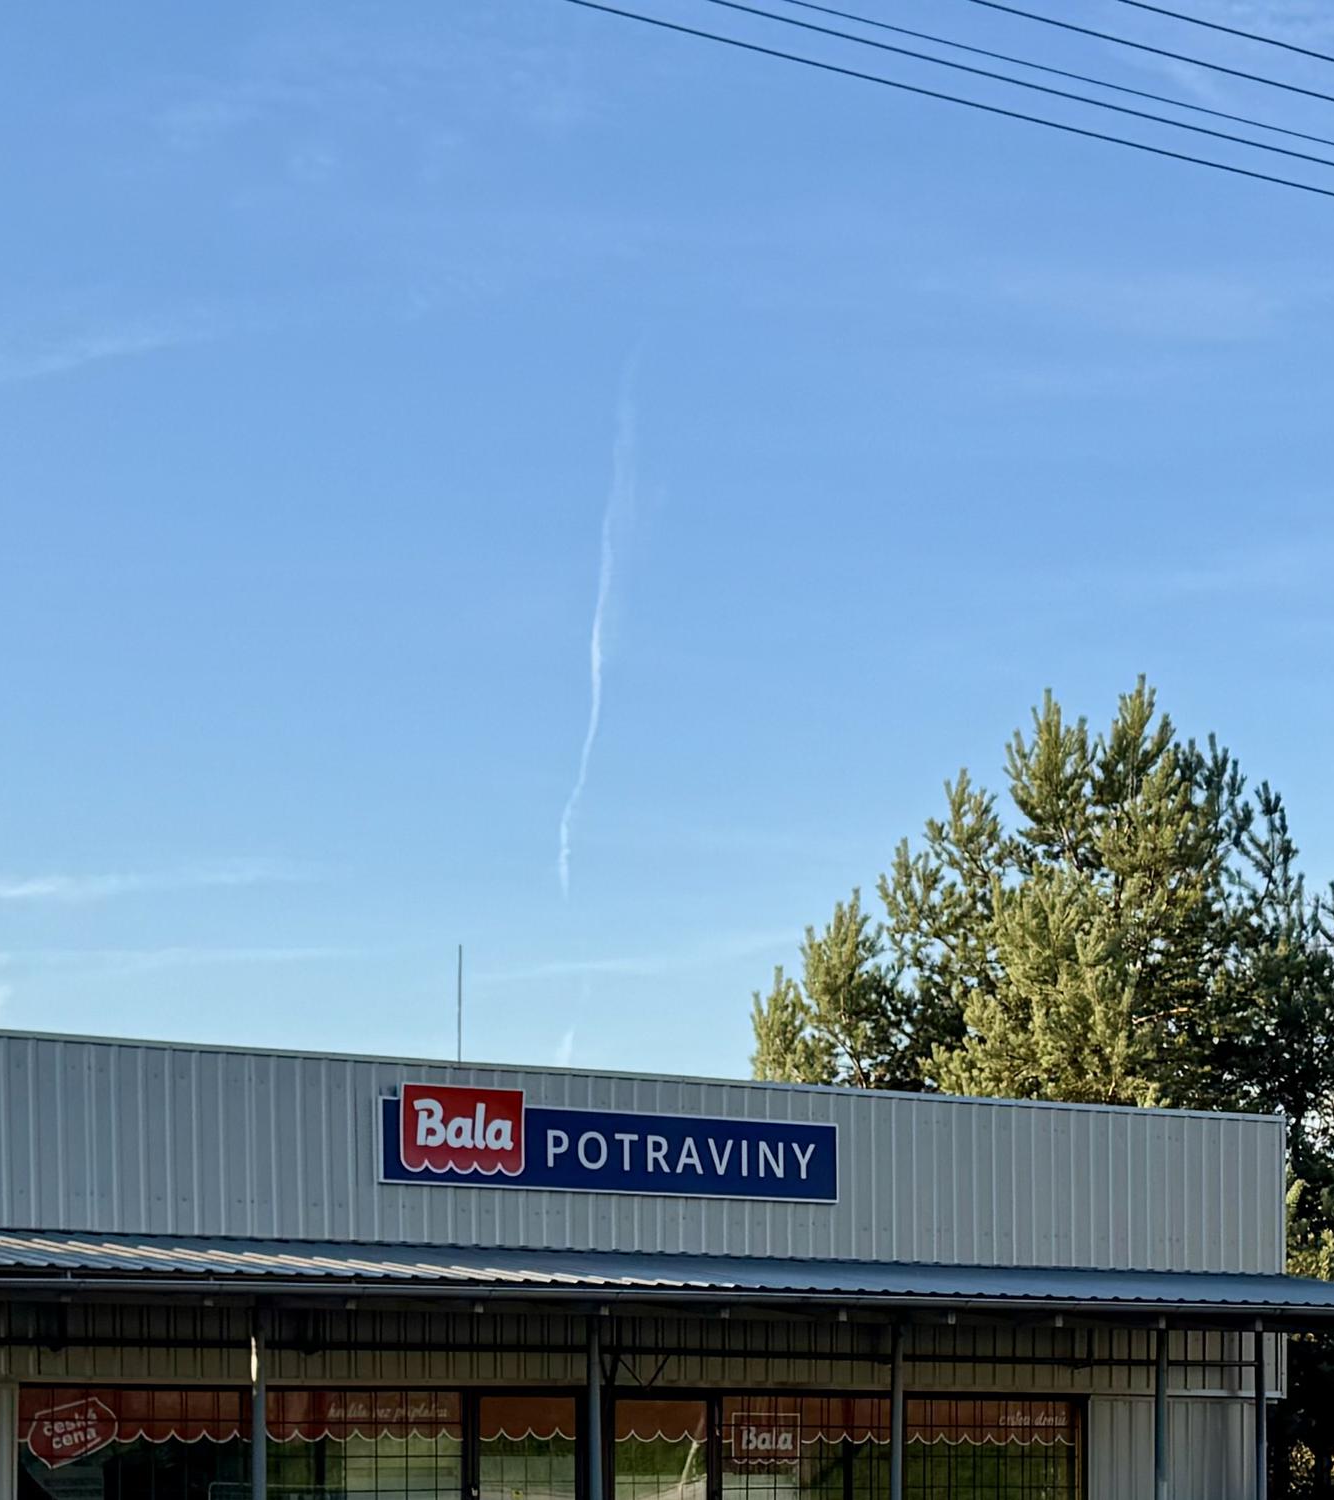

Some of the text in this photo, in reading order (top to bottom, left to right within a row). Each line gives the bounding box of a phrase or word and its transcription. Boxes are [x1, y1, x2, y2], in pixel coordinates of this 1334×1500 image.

[413, 1098, 515, 1152] Bala
[546, 1128, 816, 1180] POTRAVINY
[740, 1425, 793, 1450] Bala
